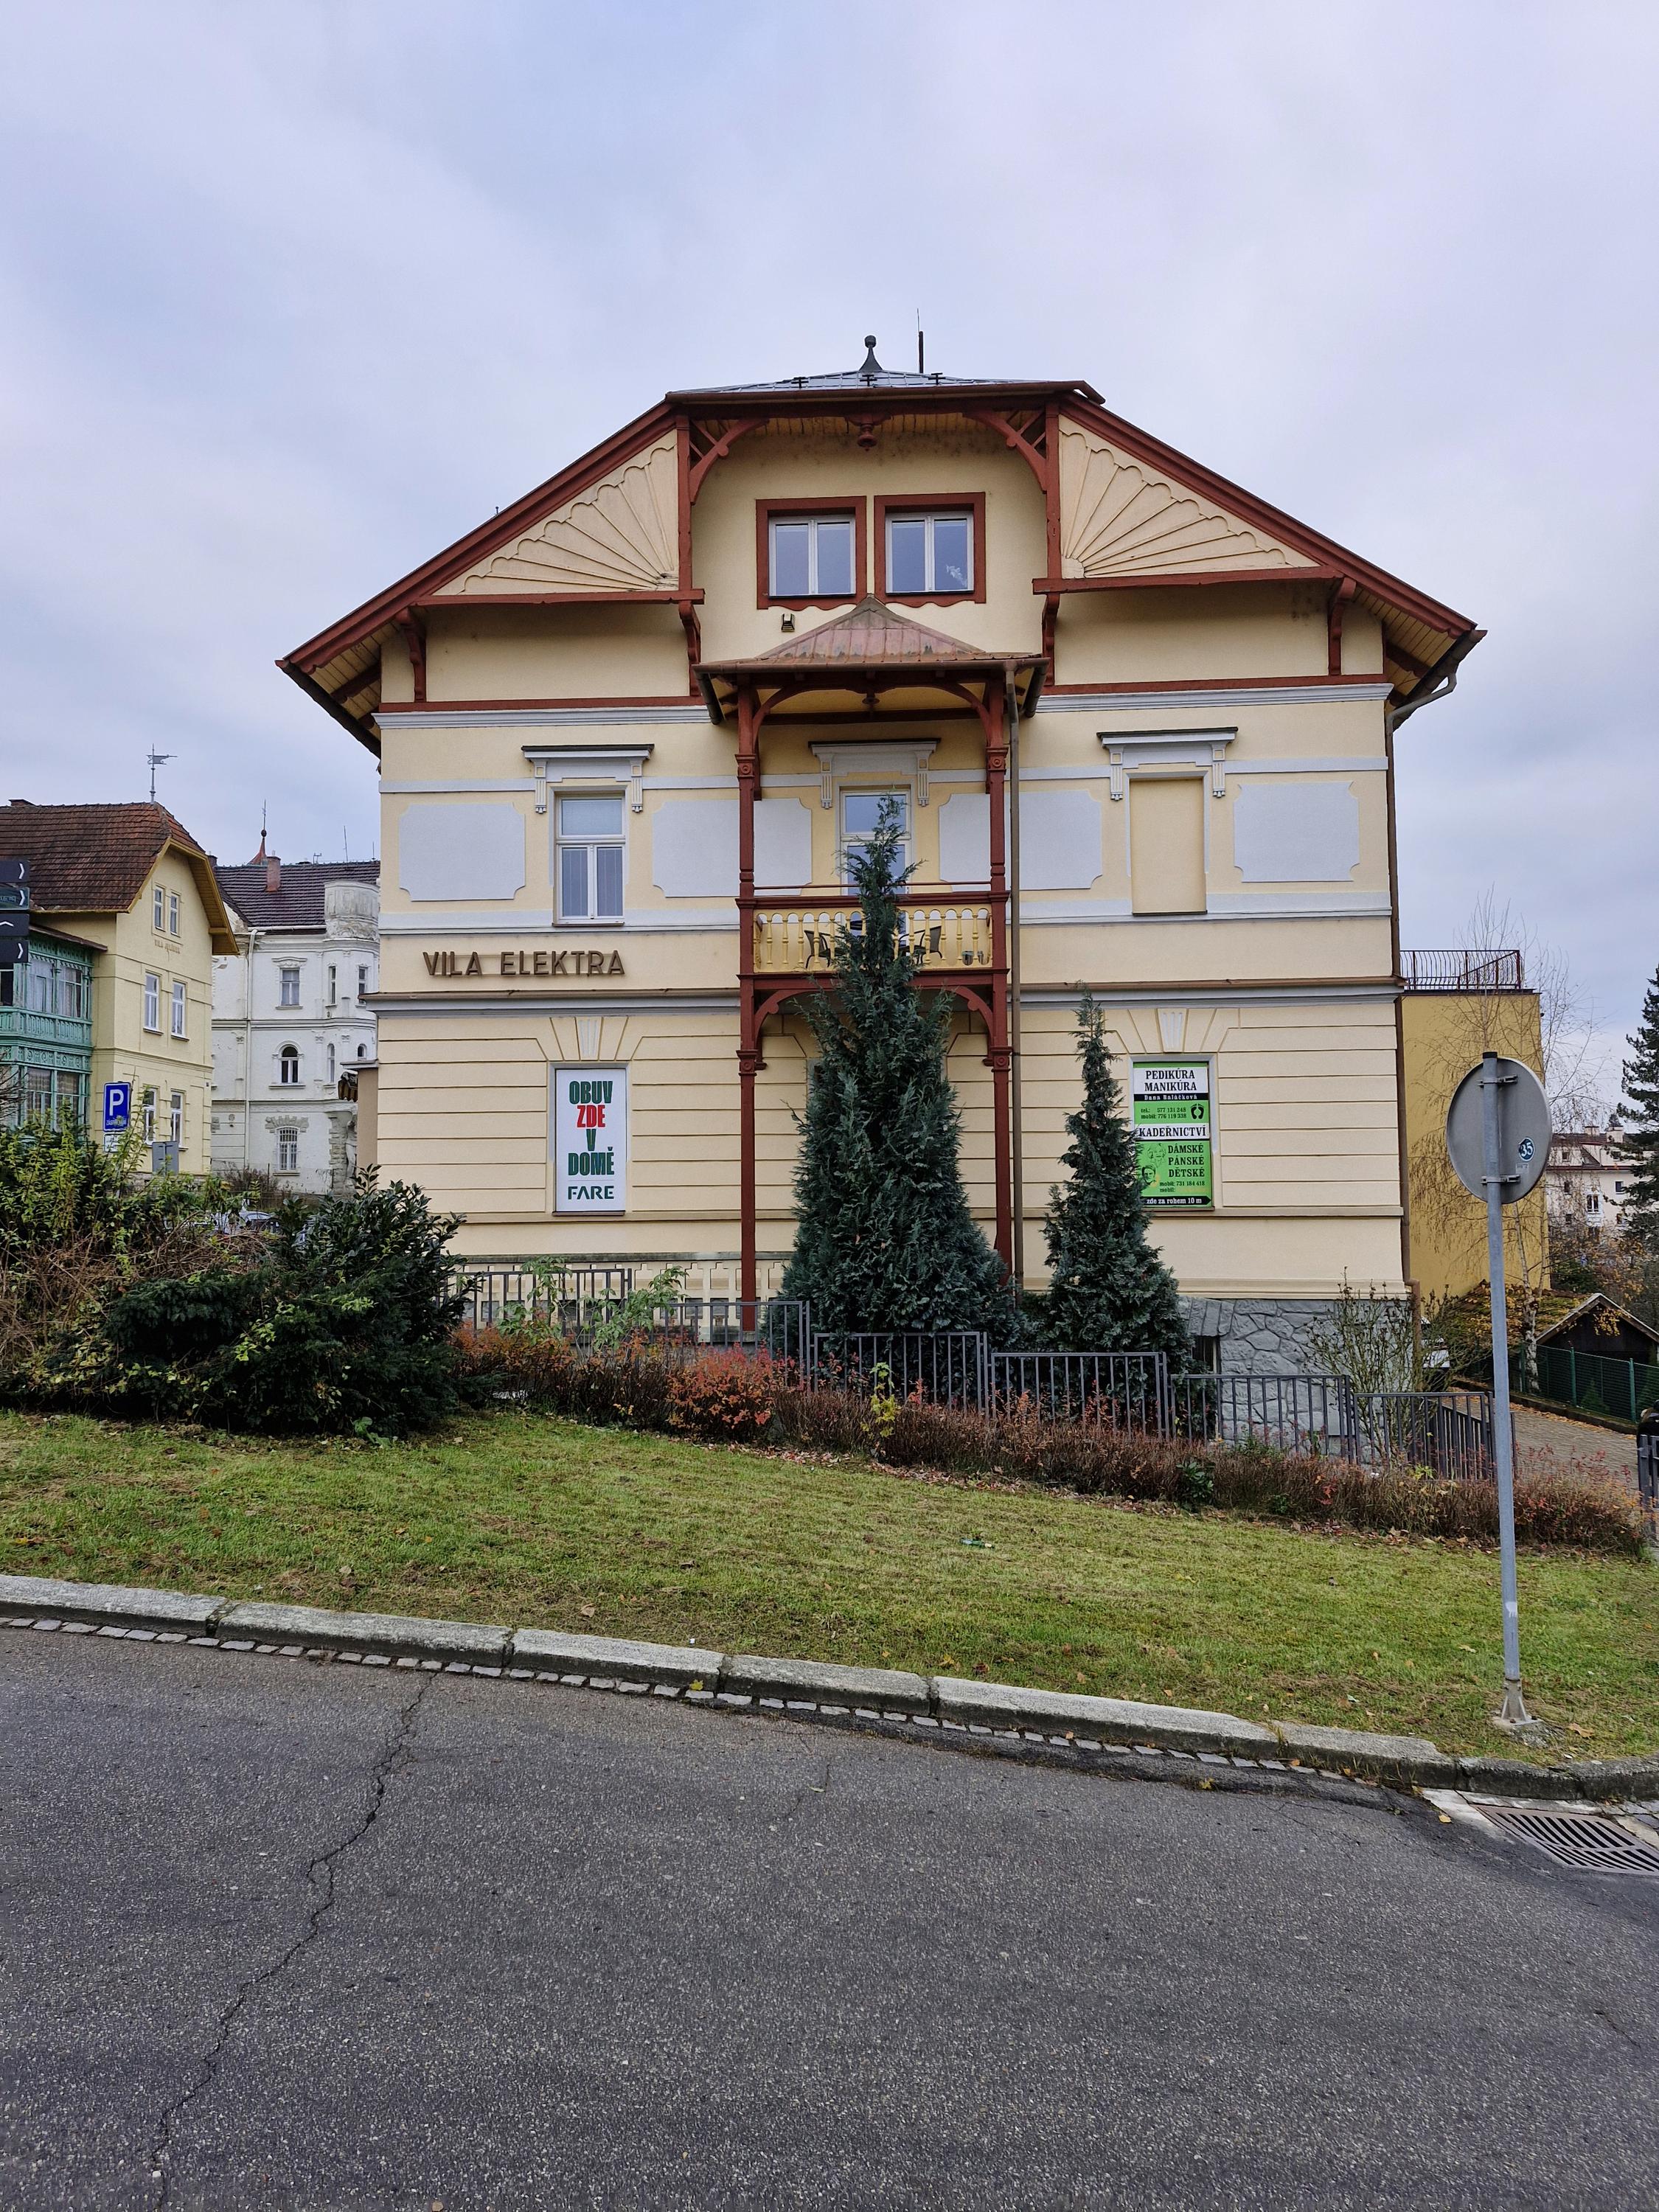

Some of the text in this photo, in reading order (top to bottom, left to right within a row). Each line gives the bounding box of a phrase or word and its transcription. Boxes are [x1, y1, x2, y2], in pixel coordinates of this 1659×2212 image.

[422, 950, 625, 976] VILA ELEKTRA
[1146, 1068, 1195, 1079] PEDIKÚRA
[1144, 1079, 1197, 1091] MANIKÚRA
[569, 1081, 613, 1105] OBUV
[109, 1089, 124, 1116] P
[577, 1105, 605, 1127] ZDE
[1139, 1124, 1206, 1137] KADEŘNICTVÍ
[586, 1128, 597, 1152] V
[1168, 1143, 1204, 1154] DÁMSKÉ
[1520, 1142, 1533, 1157] 35
[568, 1147, 615, 1176] DOMĚ
[1168, 1155, 1205, 1166] PÁNSKÉ
[1169, 1166, 1205, 1178] DĚTSKÉ
[568, 1185, 614, 1200] FARE
